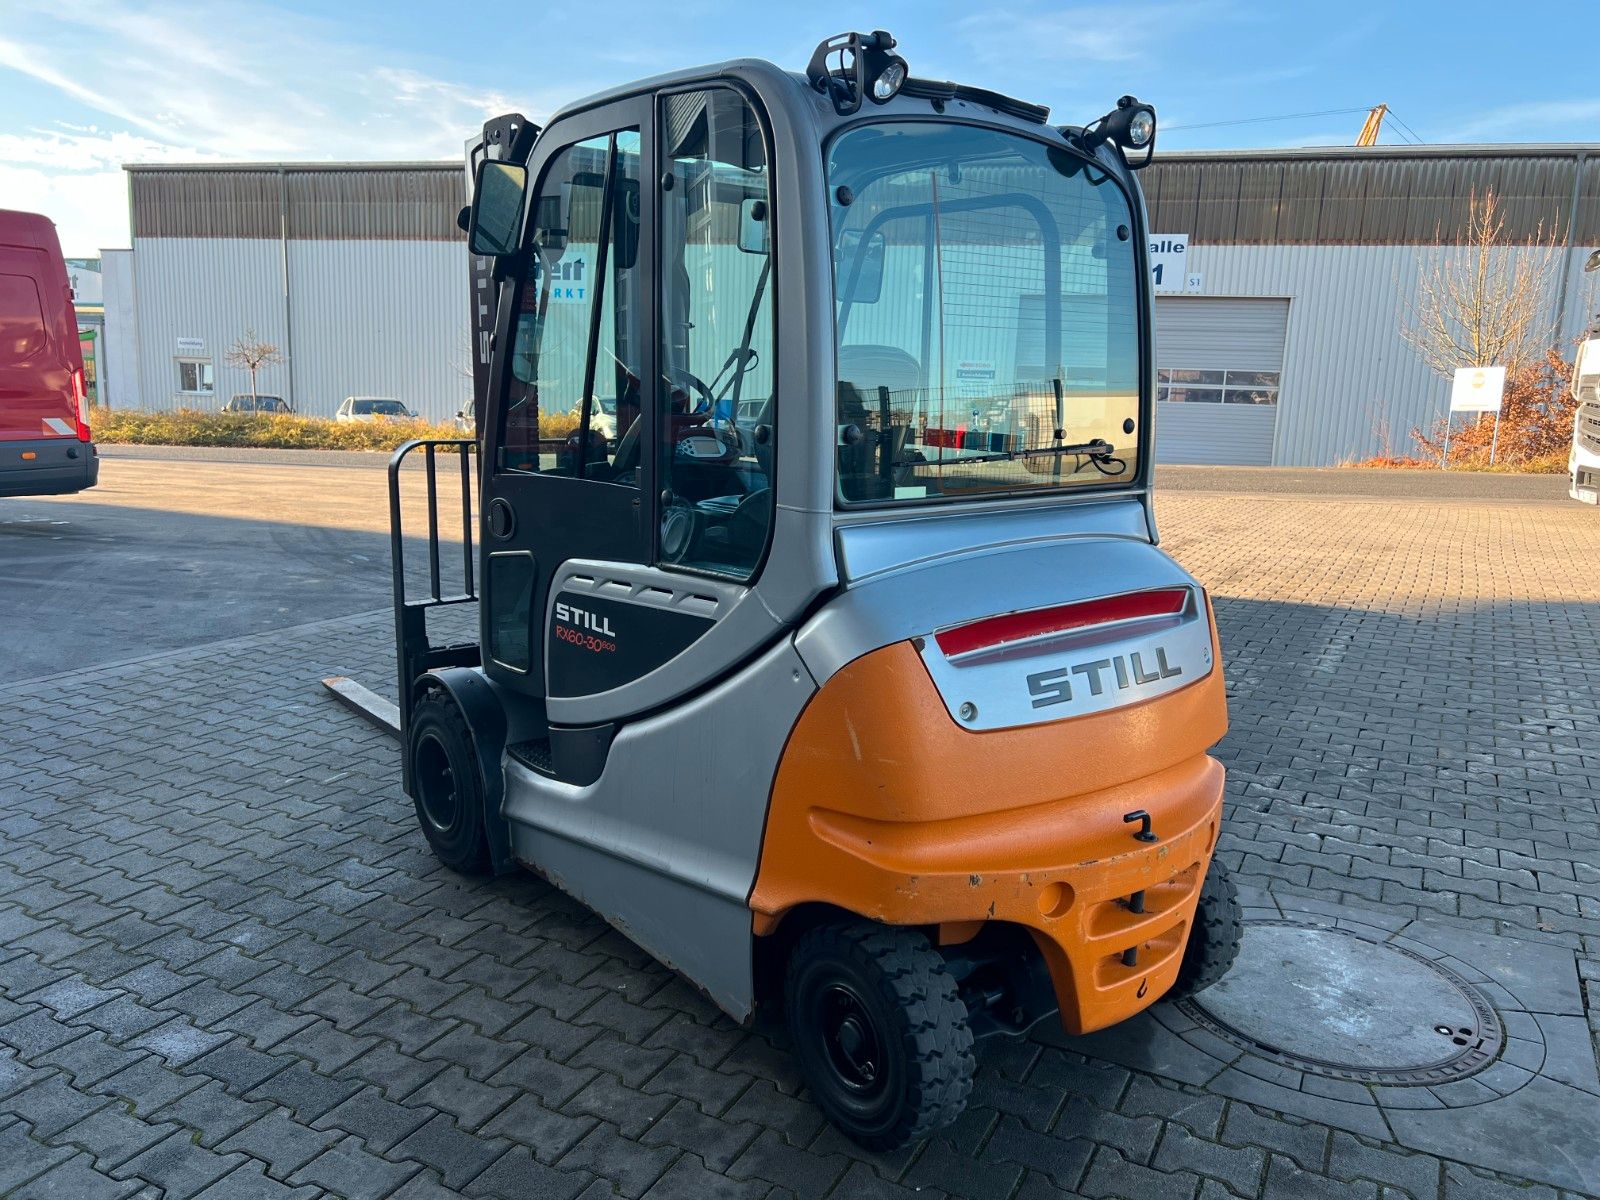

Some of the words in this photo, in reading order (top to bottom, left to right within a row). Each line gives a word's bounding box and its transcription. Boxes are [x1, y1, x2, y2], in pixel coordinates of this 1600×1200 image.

[1149, 240, 1185, 253] alle
[1152, 263, 1164, 285] 1
[536, 288, 586, 299] RKT
[476, 255, 490, 364] STIL
[556, 602, 616, 638] STILL
[1026, 646, 1182, 709] STILL
